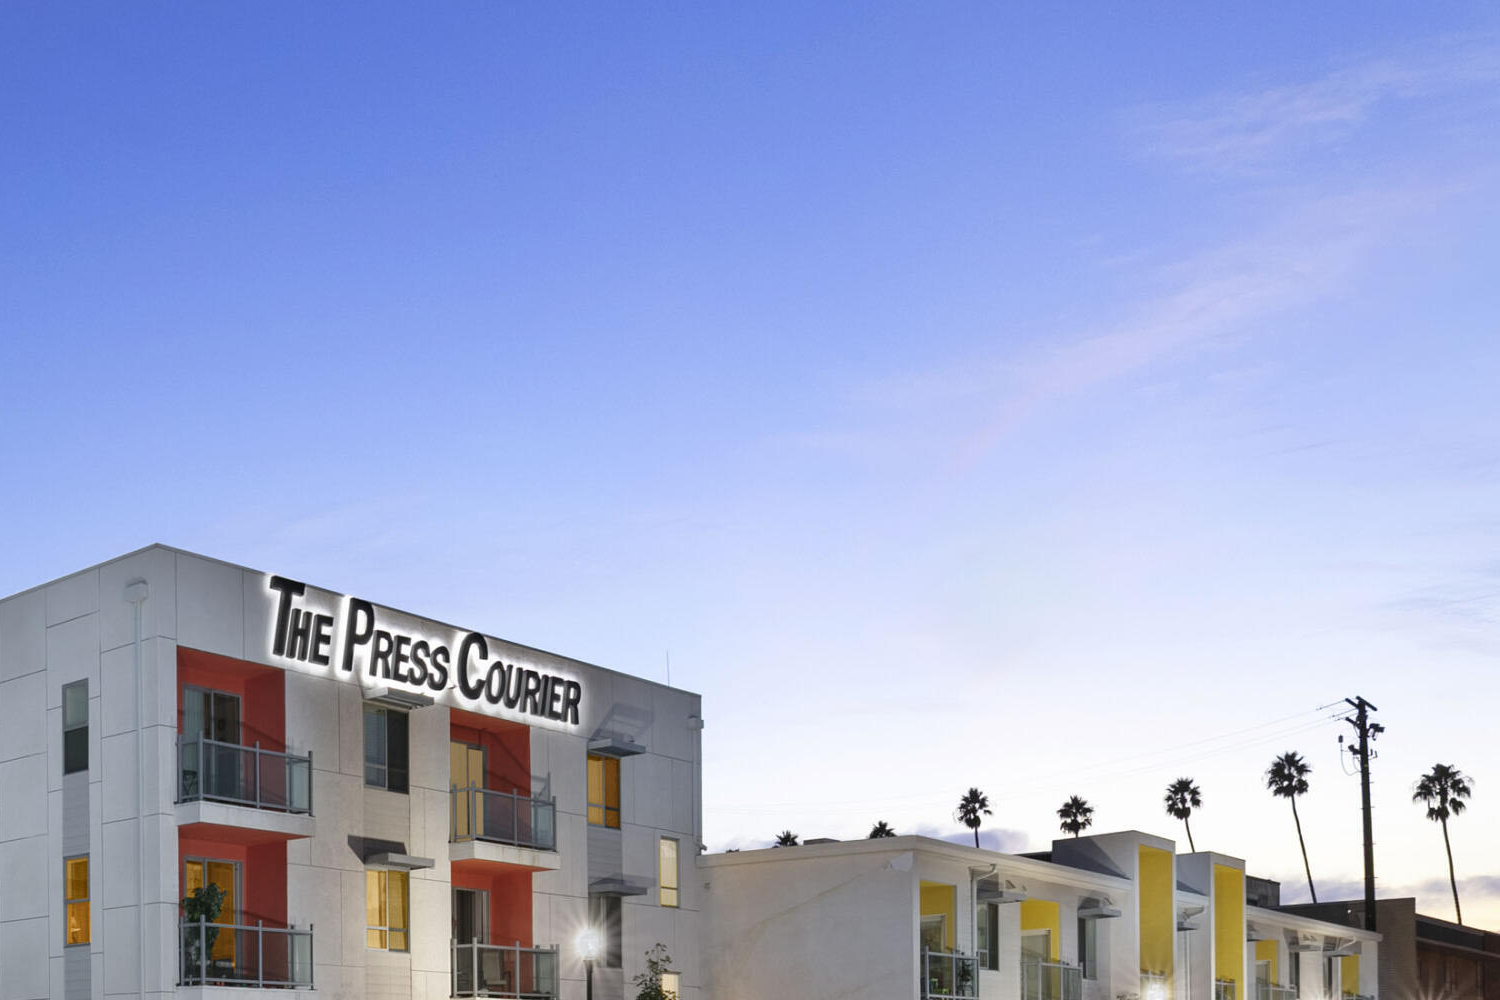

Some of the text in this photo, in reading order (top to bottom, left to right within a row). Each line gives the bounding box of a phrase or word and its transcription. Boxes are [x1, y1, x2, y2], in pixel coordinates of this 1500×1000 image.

[270, 575, 582, 725] THE PRESS COURIER
